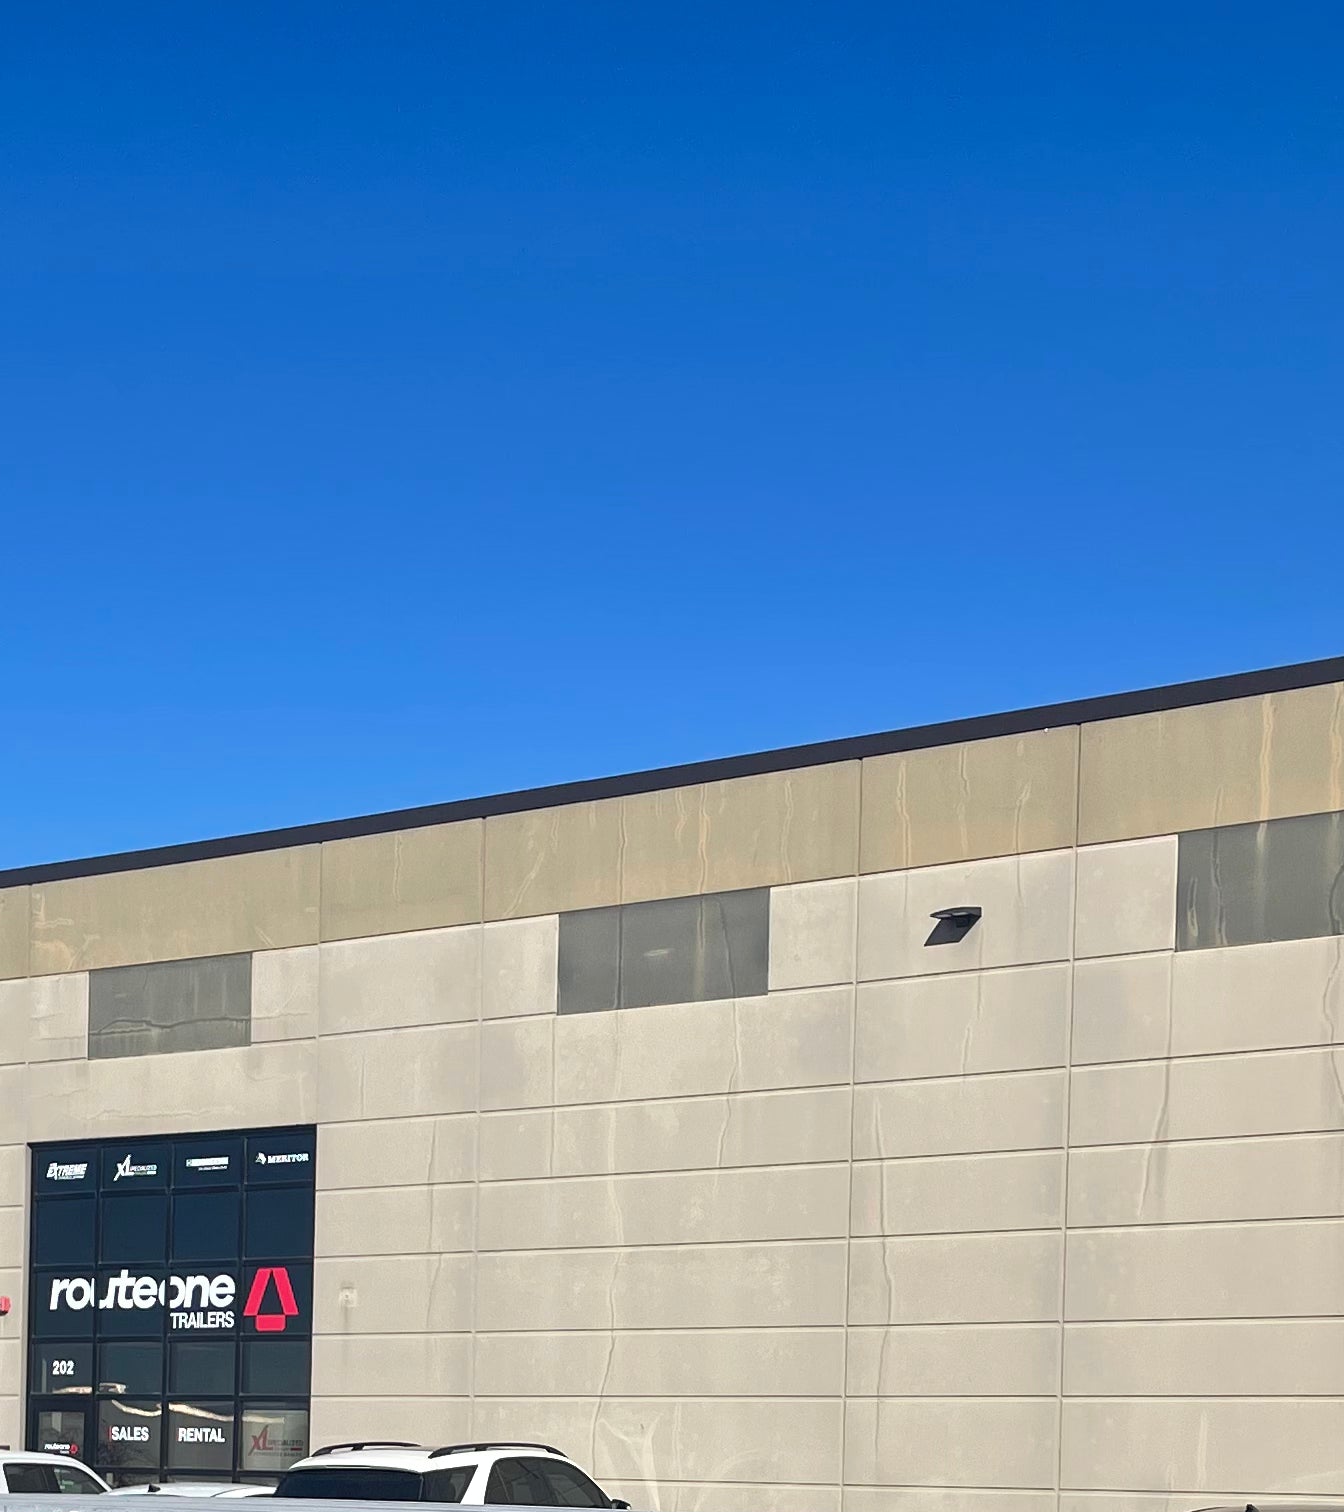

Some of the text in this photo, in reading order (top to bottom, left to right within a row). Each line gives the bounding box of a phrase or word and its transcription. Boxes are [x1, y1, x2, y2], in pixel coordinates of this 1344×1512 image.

[267, 1153, 309, 1164] MERITOR
[49, 1269, 236, 1311] routeone
[170, 1311, 235, 1329] TRAILERS
[52, 1360, 74, 1375] 202
[111, 1426, 149, 1441] SALES
[178, 1428, 225, 1442] RENTAL
